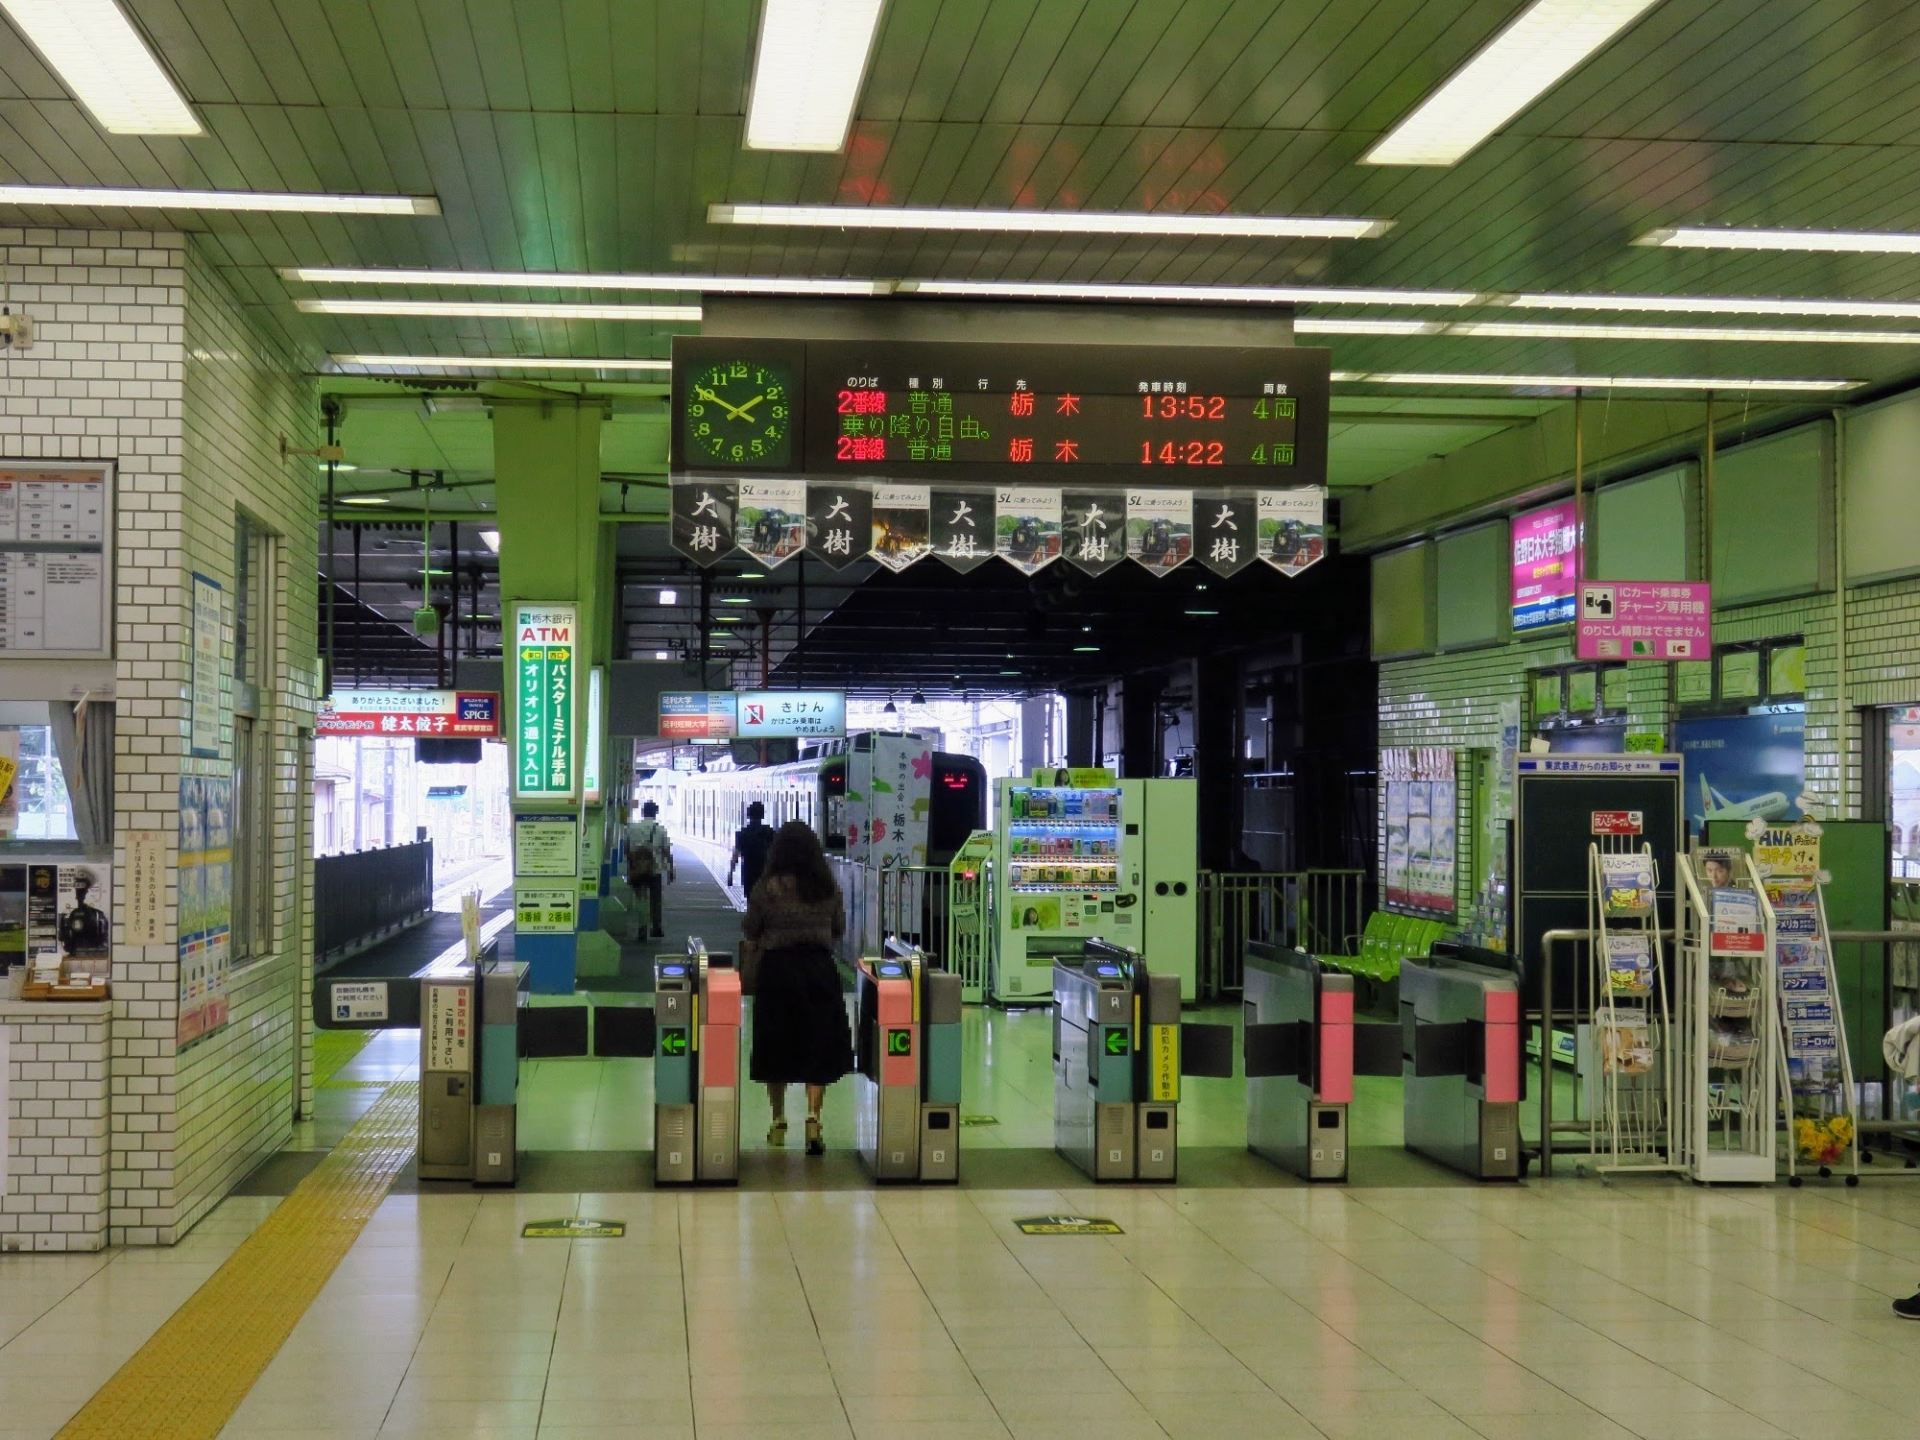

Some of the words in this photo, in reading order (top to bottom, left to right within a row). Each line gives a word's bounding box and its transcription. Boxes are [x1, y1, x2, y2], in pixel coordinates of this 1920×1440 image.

[730, 365, 748, 378] 12
[712, 373, 728, 386] 11
[756, 372, 763, 384] 1
[847, 377, 879, 388] のりば
[908, 377, 943, 389] 種別
[767, 387, 778, 399] 2
[1138, 381, 1187, 393] 発車時刻
[1263, 383, 1288, 395] 両数
[692, 404, 704, 417] 9
[837, 391, 886, 414] 2番線
[907, 391, 953, 414] 普通
[1143, 395, 1225, 419] 13:52
[1252, 397, 1297, 419] 4両
[772, 406, 783, 418] 3
[698, 423, 710, 435] 8
[764, 425, 777, 438] 4
[842, 414, 990, 440] 乗り降り自由。
[712, 439, 724, 451] 7
[731, 445, 743, 457] 6
[751, 439, 763, 452] 5
[837, 437, 885, 461] 2番線
[907, 437, 952, 460] 普通
[1141, 441, 1224, 466] 14:22
[1251, 443, 1295, 466] 4両
[740, 486, 755, 496] SL
[997, 493, 1012, 503] SL
[1128, 495, 1142, 506] SL
[1259, 496, 1274, 506] SL
[689, 491, 720, 552] 大樹
[823, 496, 854, 555] 大樹
[948, 500, 978, 560] 大樹
[1078, 503, 1109, 563] 大樹
[1210, 504, 1240, 563] 大樹
[1619, 587, 1691, 599] ICカード乗車券
[1619, 601, 1705, 615] チャージ専用機
[532, 613, 573, 625] 栃木銀行
[521, 627, 569, 642] ATM
[1582, 625, 1705, 637] のりこし精算はできません
[662, 696, 693, 704] 足利大学
[781, 701, 824, 713] きけん
[463, 710, 490, 720] SPICE
[771, 717, 822, 725] かけこみ乗車は
[381, 715, 449, 732] 健太餃子
[524, 663, 539, 787] オリオン通り入口
[551, 664, 567, 787] バスターミナル手前
[795, 725, 836, 733] やめましょう
[1545, 761, 1632, 772] 東武鉄道からのお知らせ
[892, 812, 906, 843] 栃木
[518, 912, 542, 922] 3番線
[548, 912, 572, 922] 2番線
[1784, 978, 1808, 989] アジア
[457, 988, 467, 1048] 自動改札機を
[444, 1008, 454, 1069] ご利用下さい。
[888, 1032, 911, 1052] IC
[1801, 1037, 1835, 1047] ヨーロッパ
[1161, 1027, 1170, 1099] 防犯カメラ作動中
